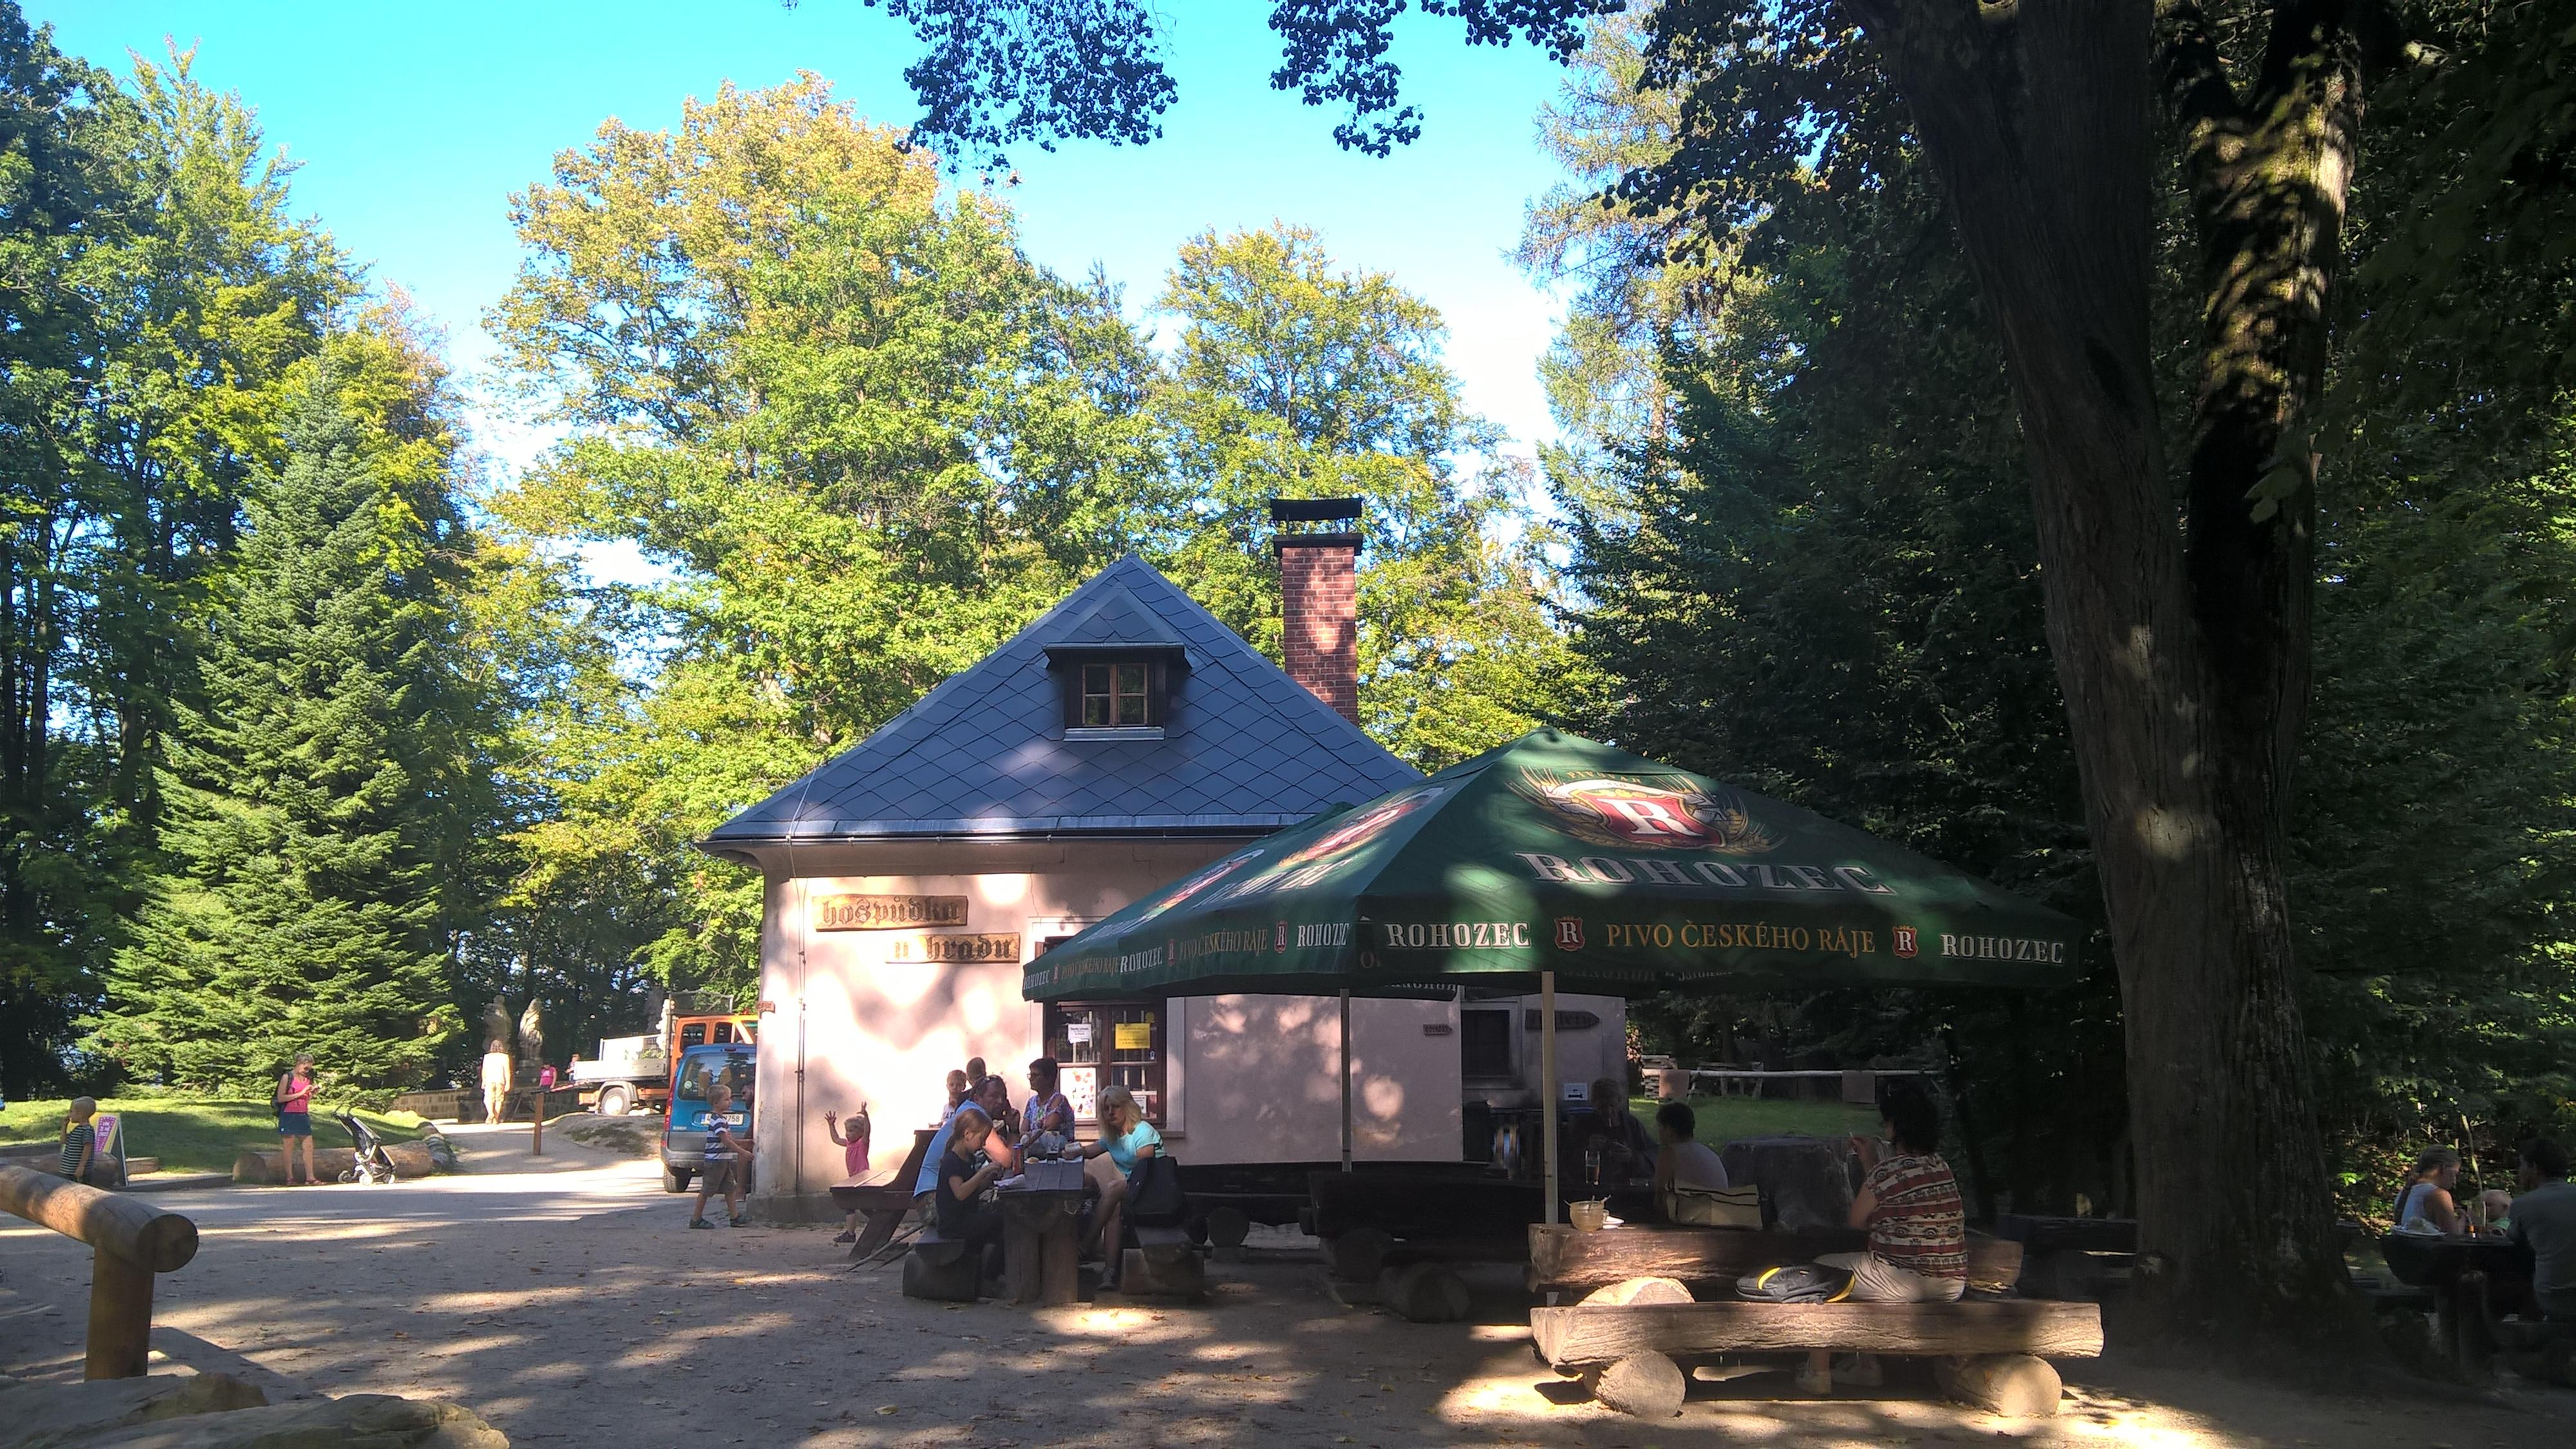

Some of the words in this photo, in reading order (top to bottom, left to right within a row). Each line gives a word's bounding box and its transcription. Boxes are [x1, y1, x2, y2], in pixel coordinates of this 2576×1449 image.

[1596, 799, 1703, 837] R
[1514, 851, 1897, 895] ROHOZEC
[1120, 947, 1162, 973] ROHOZEC
[1385, 923, 1531, 948] ROHOZEC
[1560, 922, 1579, 943] R
[1606, 923, 1674, 948] PIVO
[1680, 919, 1810, 951] ČESKÉHO
[1818, 926, 1875, 959] RÁJE
[1897, 931, 1913, 952] R
[1940, 933, 2064, 964] ROHOZEC
